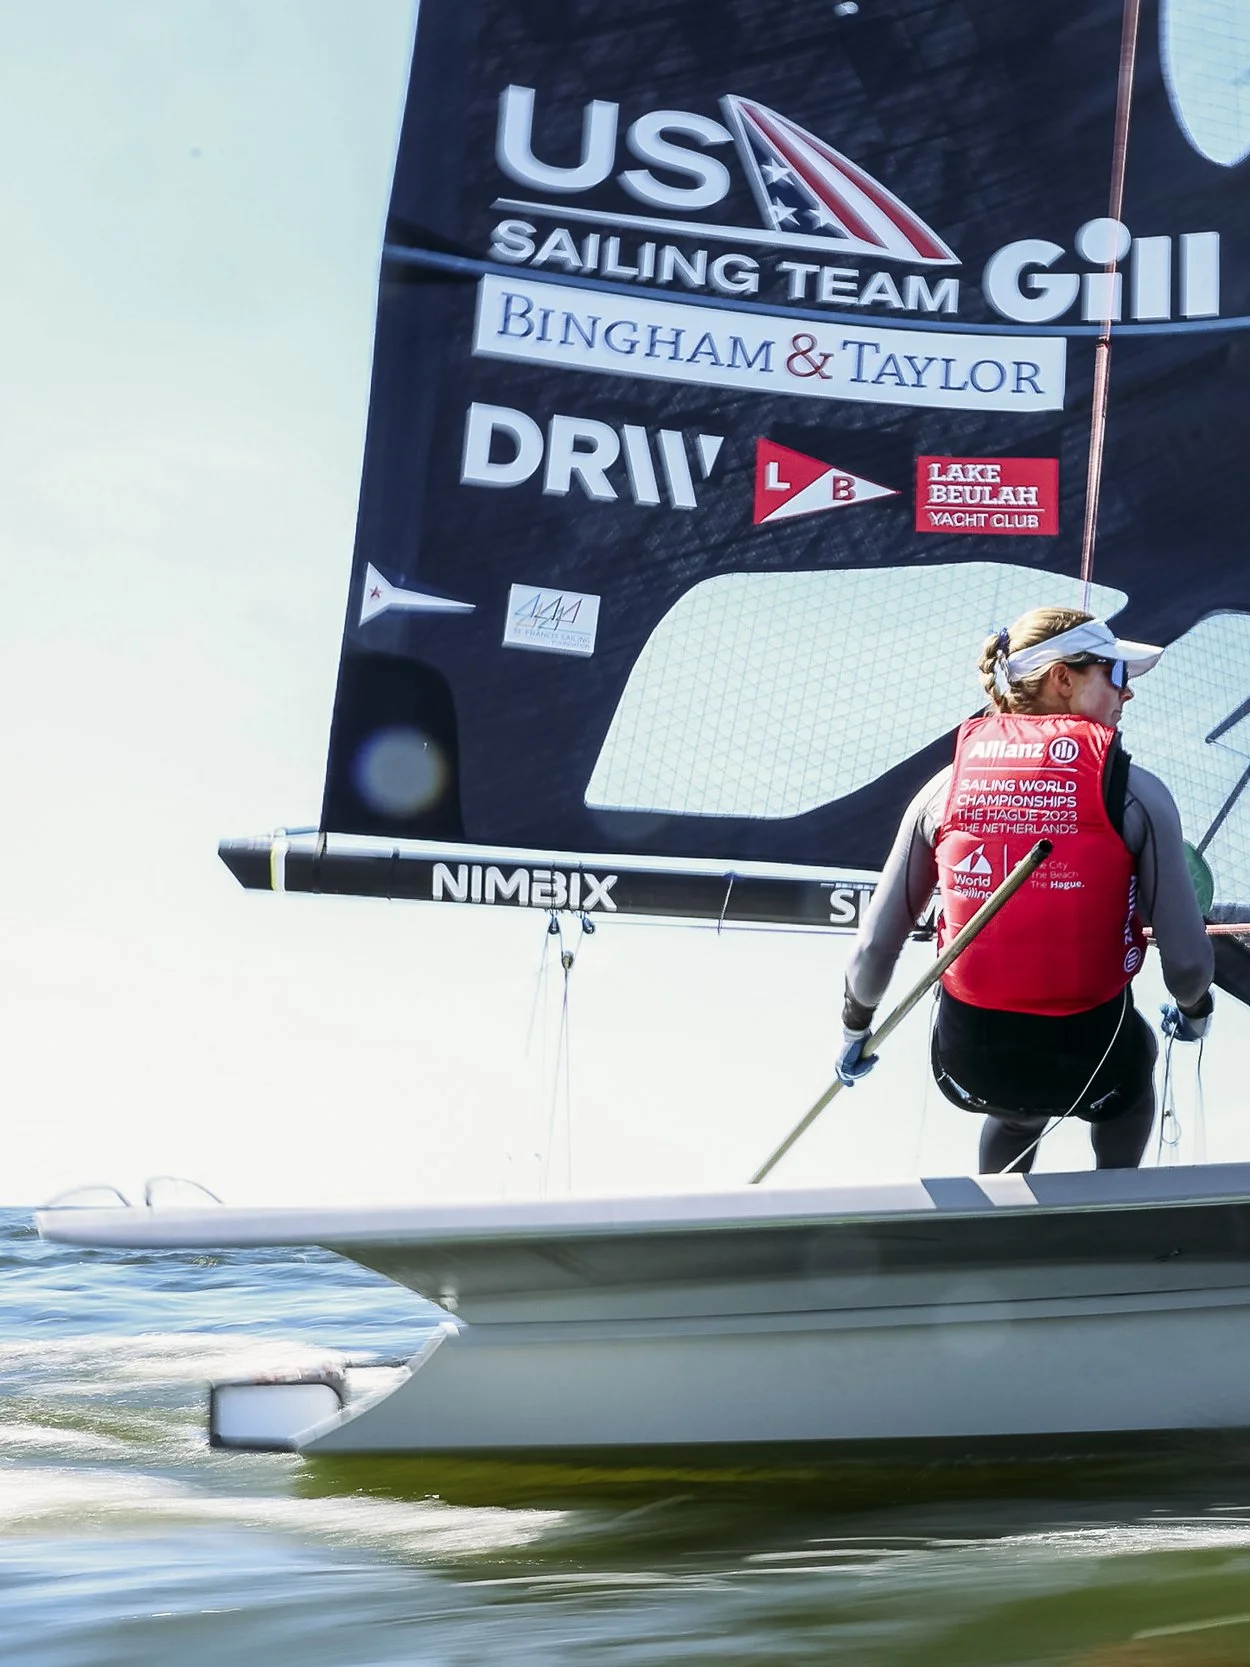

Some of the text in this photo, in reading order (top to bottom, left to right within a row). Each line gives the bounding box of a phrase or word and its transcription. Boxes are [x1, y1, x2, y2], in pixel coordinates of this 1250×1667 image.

[495, 84, 734, 211] US
[489, 219, 961, 315] SAILING TEAM
[982, 217, 1220, 323] Gill
[496, 291, 1046, 394] BINGHAM & TAYLOR
[459, 401, 725, 511] DRW
[765, 461, 857, 501] L B
[927, 462, 1002, 483] LAKE
[928, 484, 1038, 506] BEULAH
[930, 511, 1040, 529] YACHT CLUB
[967, 740, 1045, 759] Allianz
[960, 779, 1077, 793] SAILING WORLD
[956, 793, 1077, 809] CHAMPIONSHIPS
[957, 808, 1078, 822] THE HAGUE 2023
[958, 822, 1079, 835] THE NETHERLANDS
[432, 862, 619, 912] NIMBIX
[953, 872, 991, 888] World
[1049, 880, 1086, 891] Hague.
